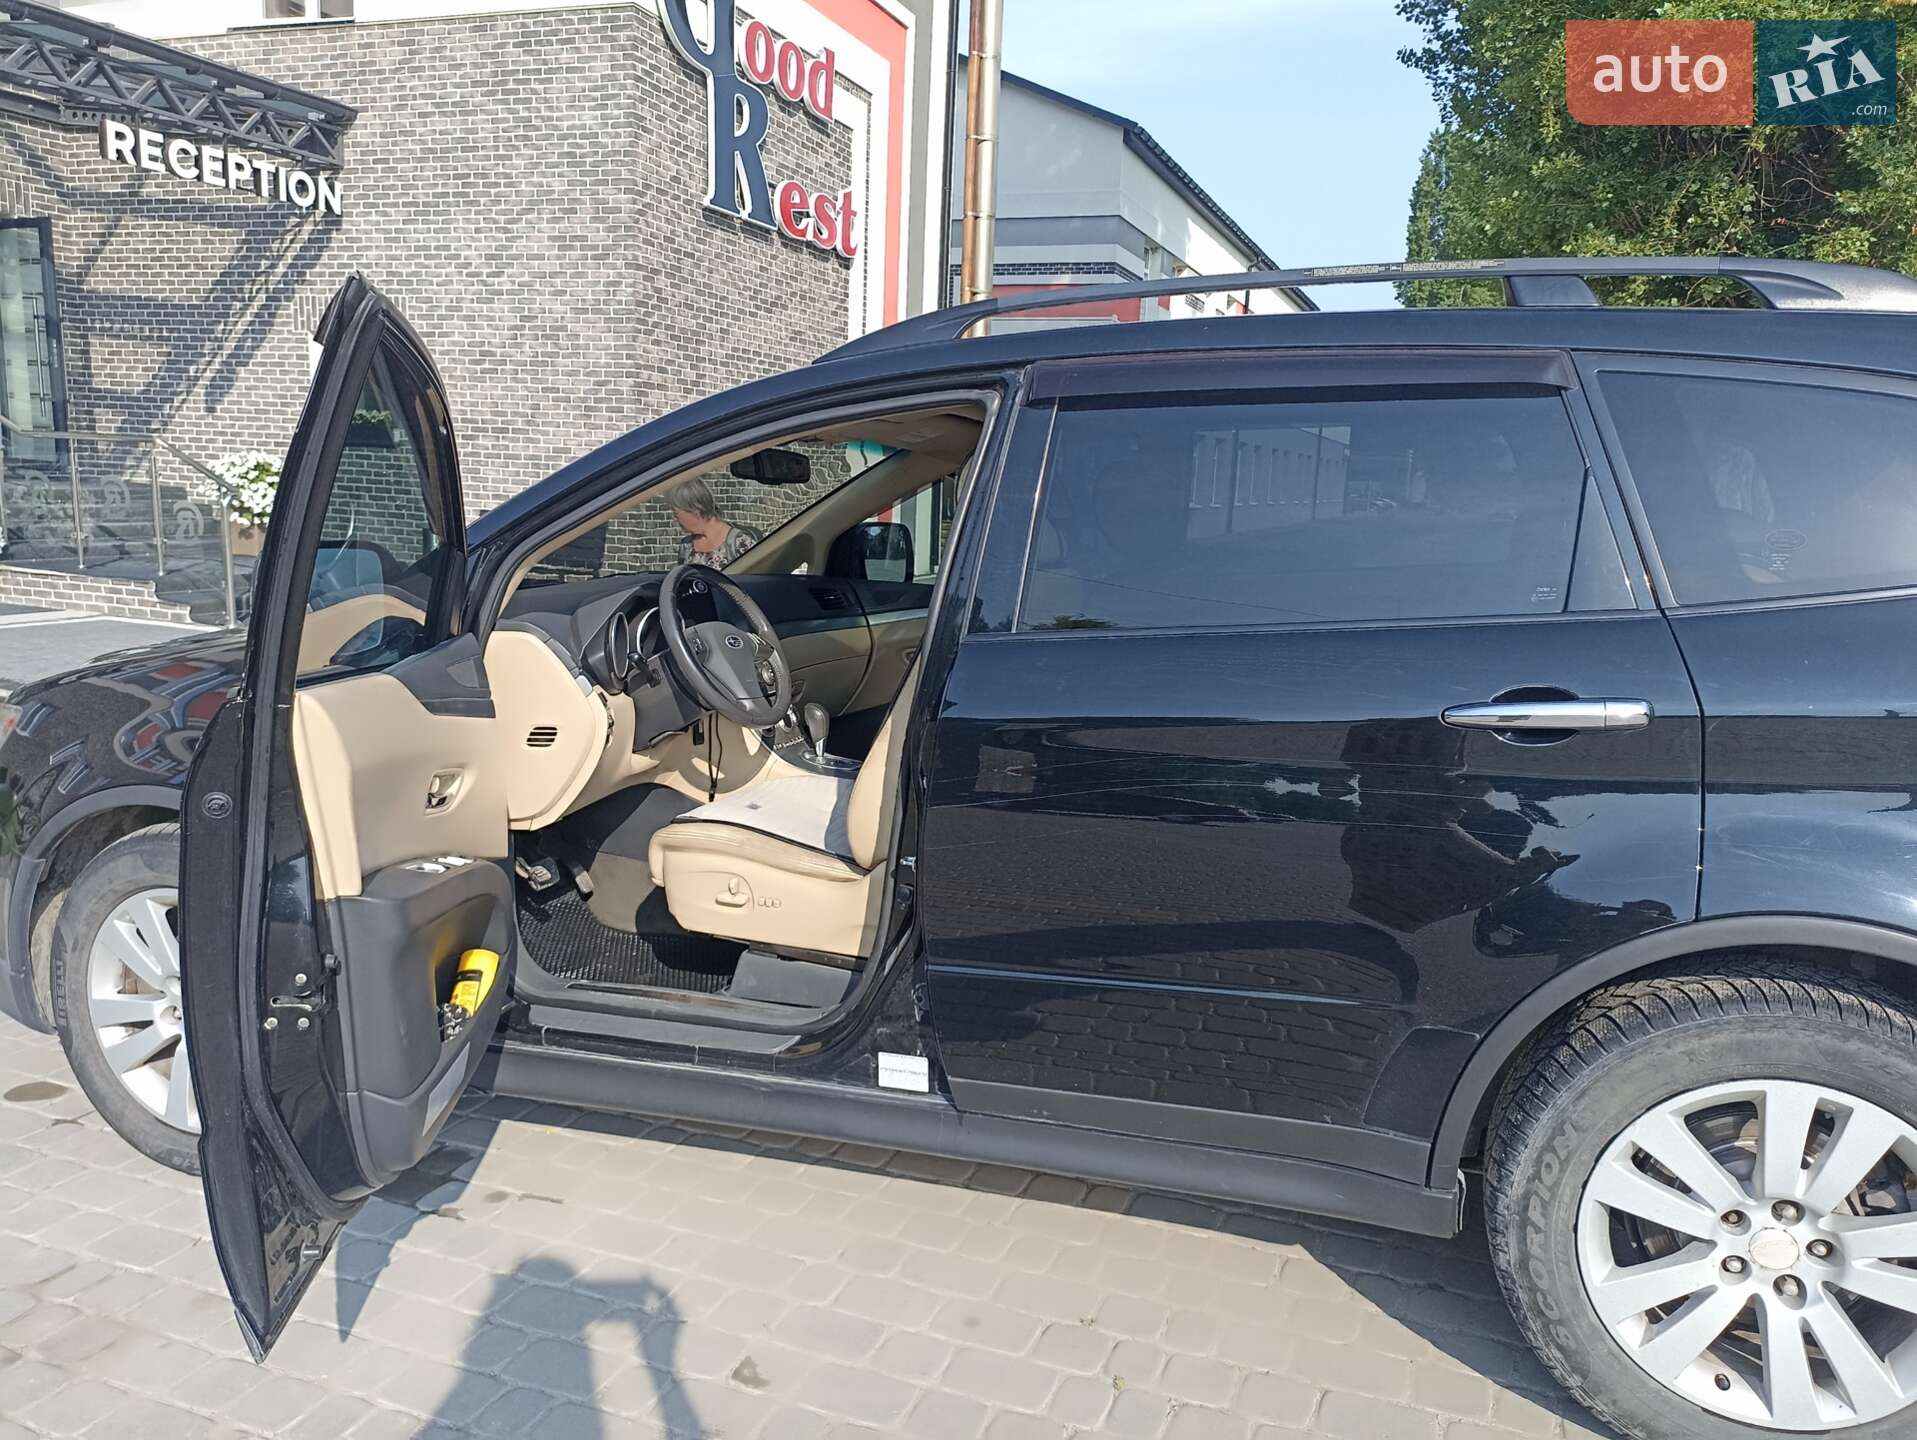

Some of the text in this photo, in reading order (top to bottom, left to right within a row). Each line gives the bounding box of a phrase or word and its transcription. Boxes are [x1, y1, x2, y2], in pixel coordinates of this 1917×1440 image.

[102, 119, 342, 216] RECEPTION
[704, 72, 858, 258] Rest
[1527, 1120, 1578, 1350] SCORPION
